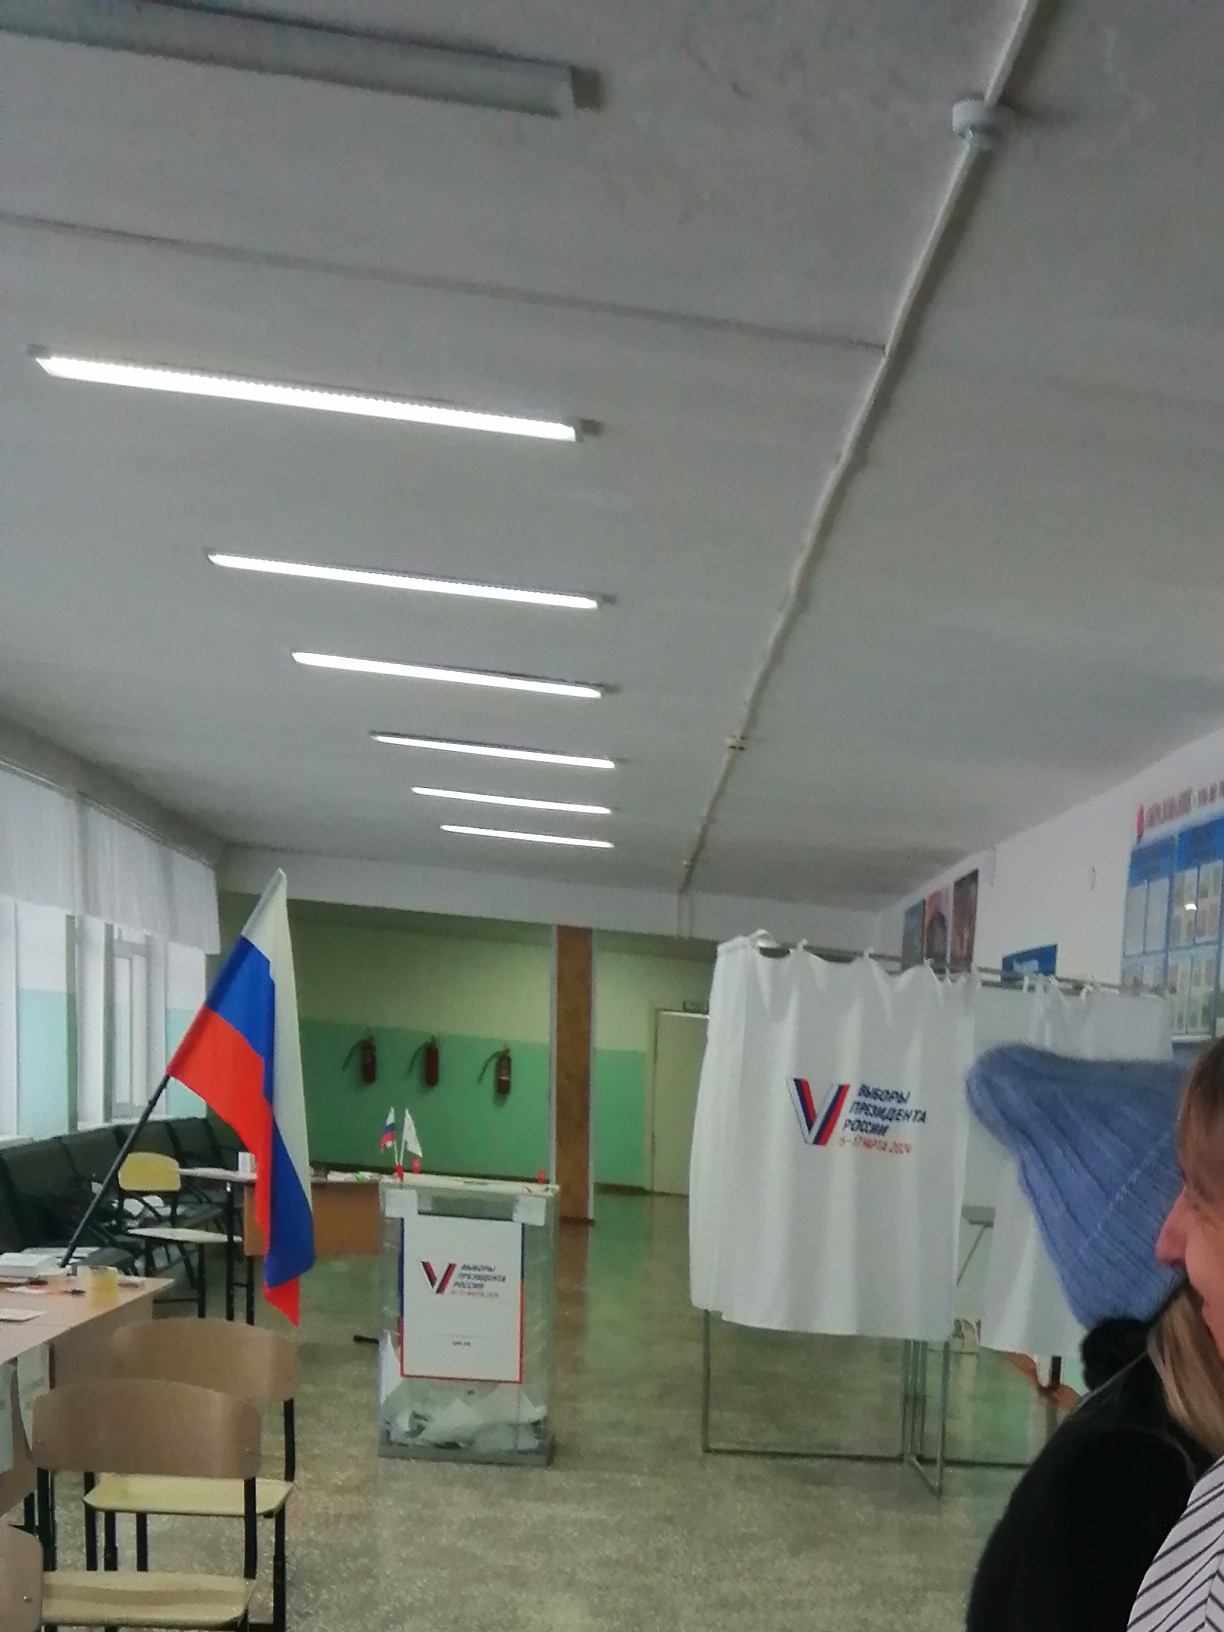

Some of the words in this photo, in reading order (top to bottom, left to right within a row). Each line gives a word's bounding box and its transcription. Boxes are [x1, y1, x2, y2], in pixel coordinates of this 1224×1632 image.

[858, 1083, 911, 1104] ВЫБОРЫ
[849, 1101, 927, 1124] ПРЕЗИДЕНТА
[843, 1119, 890, 1136] РОССИИ
